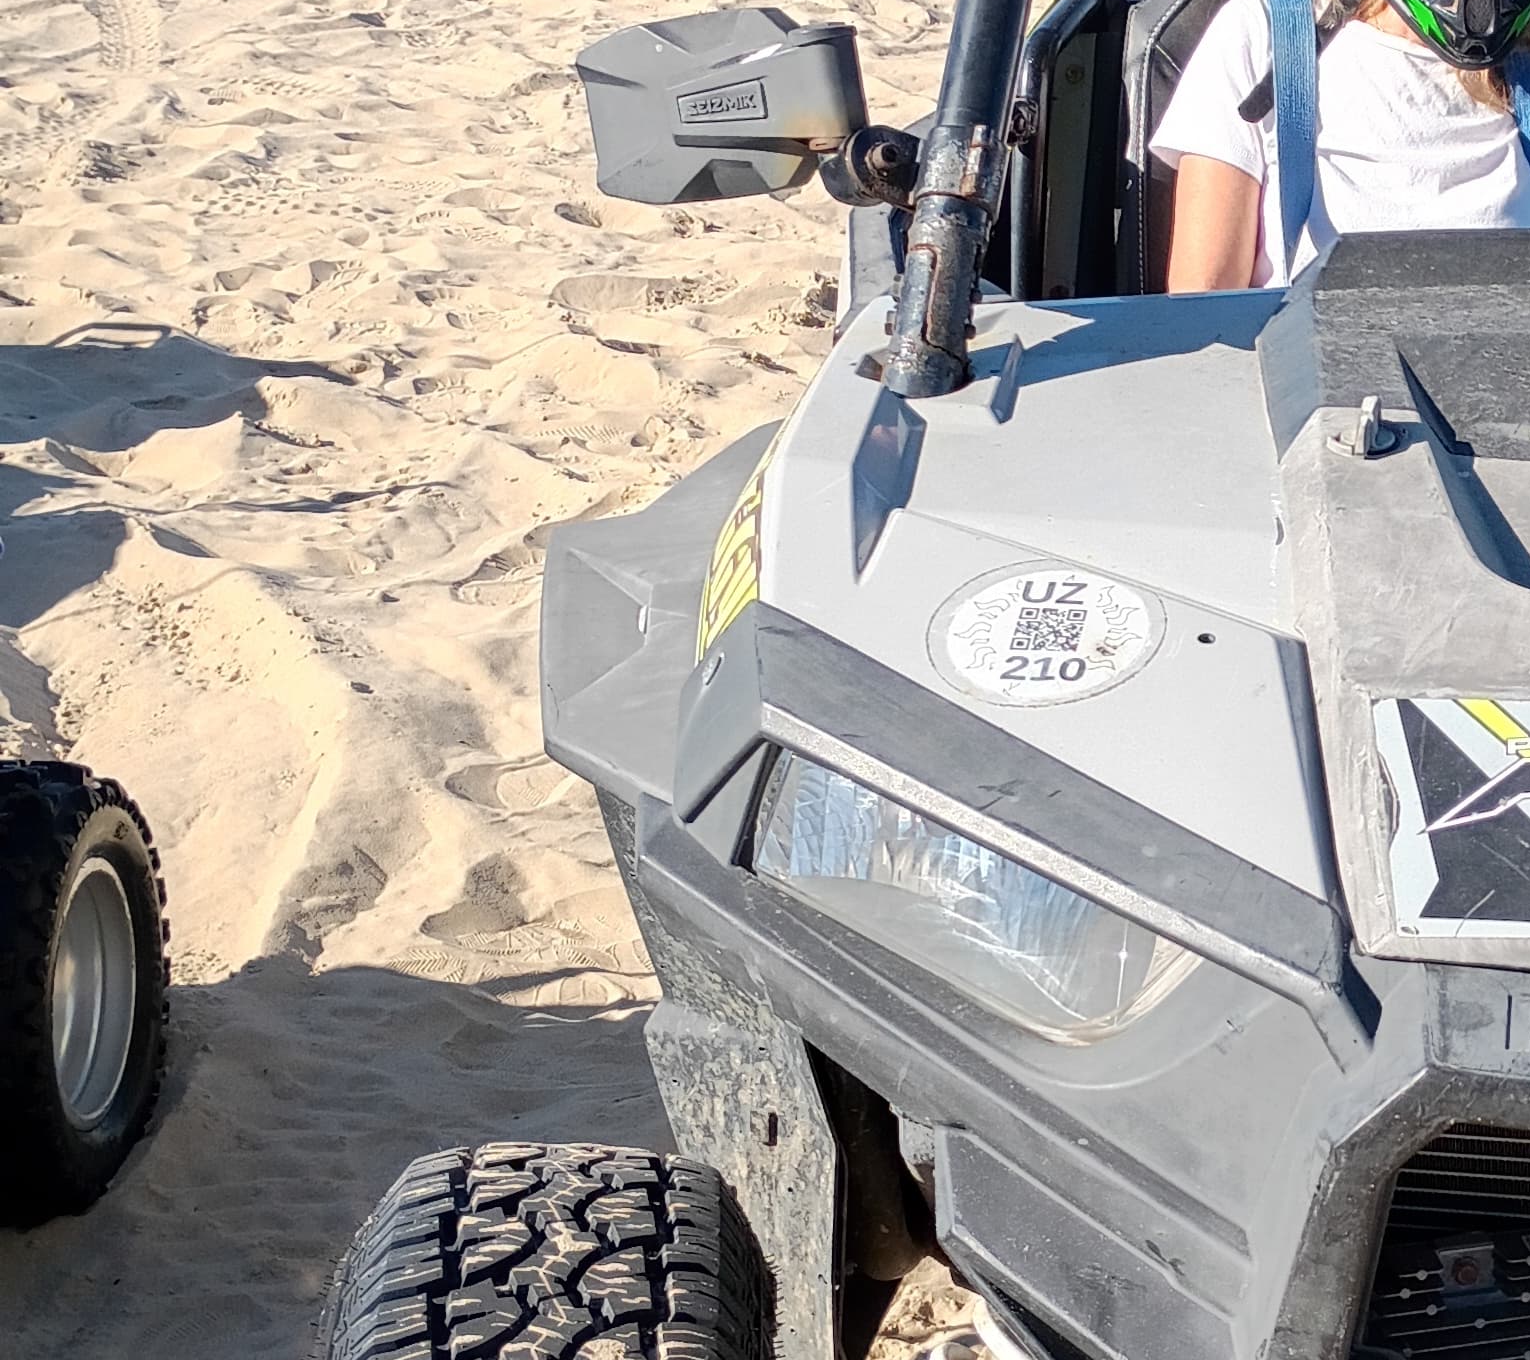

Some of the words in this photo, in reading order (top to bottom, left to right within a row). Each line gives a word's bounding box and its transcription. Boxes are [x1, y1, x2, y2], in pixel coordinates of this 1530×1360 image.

[685, 93, 757, 117] SEIZMIK
[1022, 581, 1088, 605] UZ
[1000, 656, 1087, 681] 210
